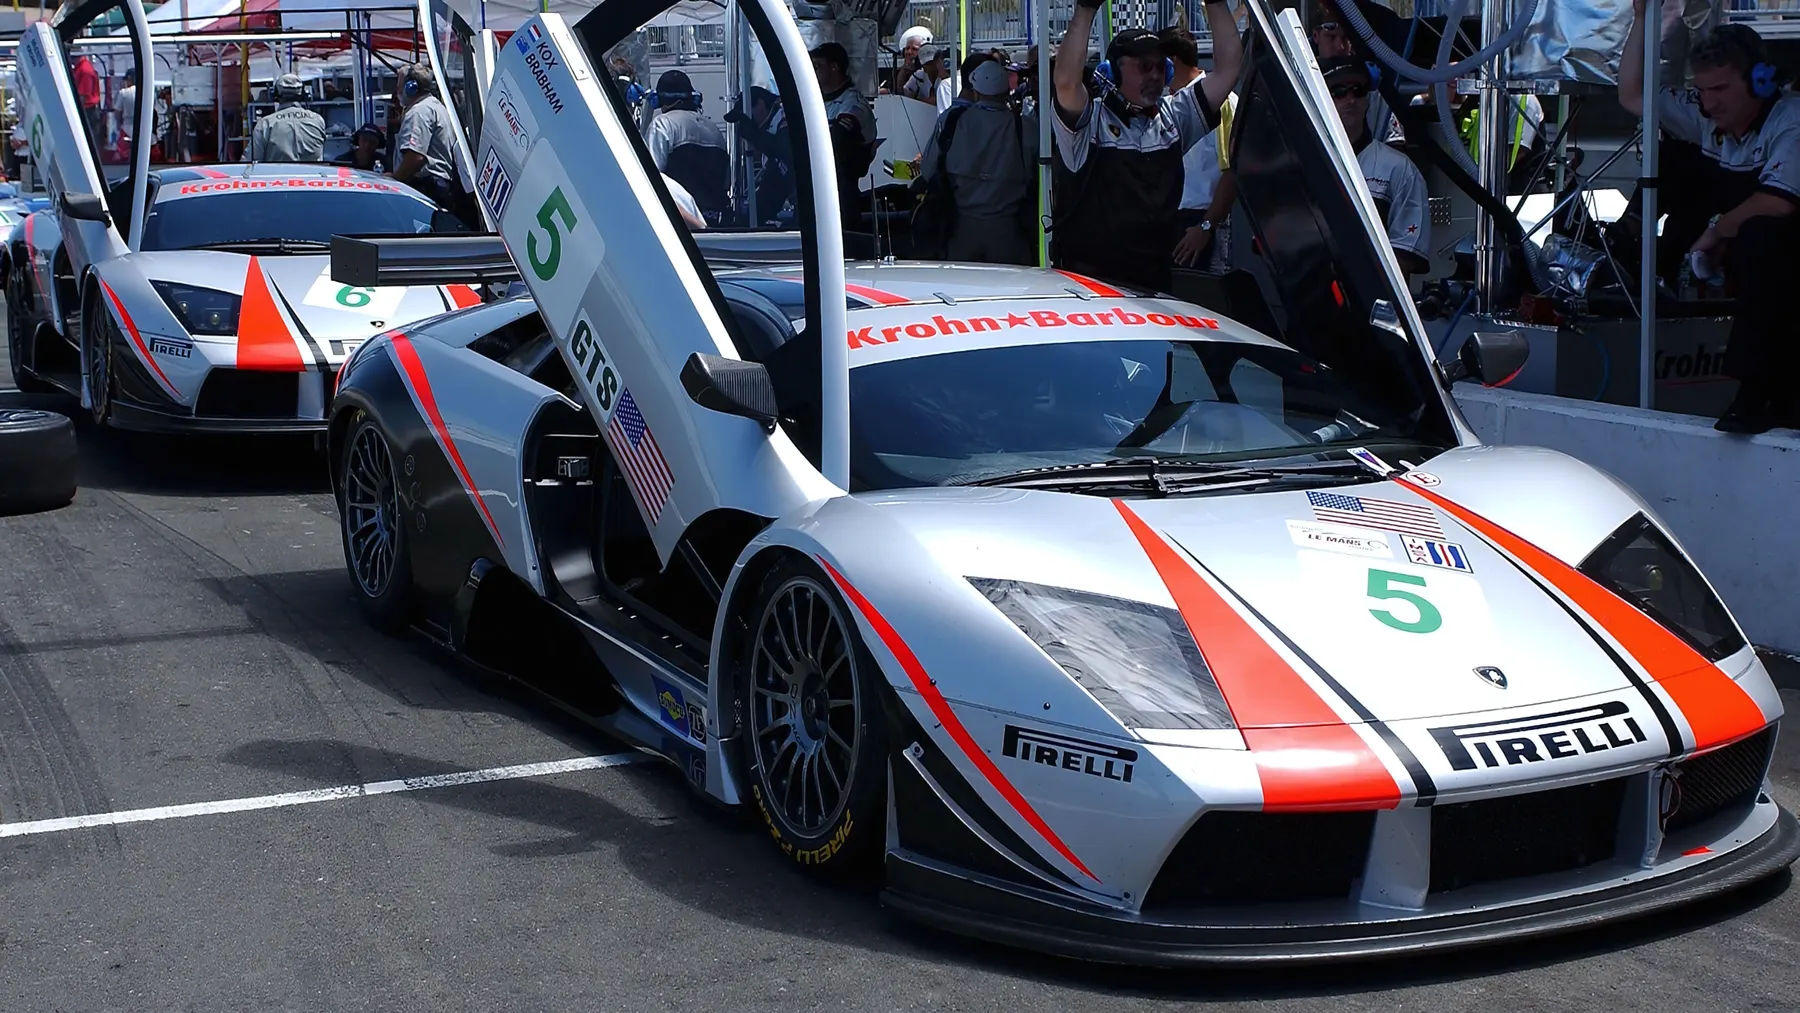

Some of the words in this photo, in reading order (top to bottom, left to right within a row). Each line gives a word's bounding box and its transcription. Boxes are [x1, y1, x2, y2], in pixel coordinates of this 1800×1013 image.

[536, 41, 558, 71] KOX
[525, 53, 564, 114] BRABHAM
[32, 114, 44, 159] 6
[275, 112, 313, 120] OFFICIAL
[498, 97, 506, 113] LE
[503, 111, 520, 136] MANS
[181, 180, 267, 194] Krohn
[526, 185, 578, 282] 5
[336, 285, 376, 308] 6
[150, 337, 193, 359] PIRELLI
[846, 315, 1002, 350] Krohn
[1034, 307, 1220, 332] Barbour
[571, 319, 618, 412] GTS
[1308, 533, 1322, 541] LE
[1326, 536, 1361, 546] MANS
[1366, 567, 1443, 634] 5
[1001, 724, 1139, 784] PIRELLI
[1427, 700, 1648, 772] PIRELLI
[797, 808, 853, 865] PIRELLI
